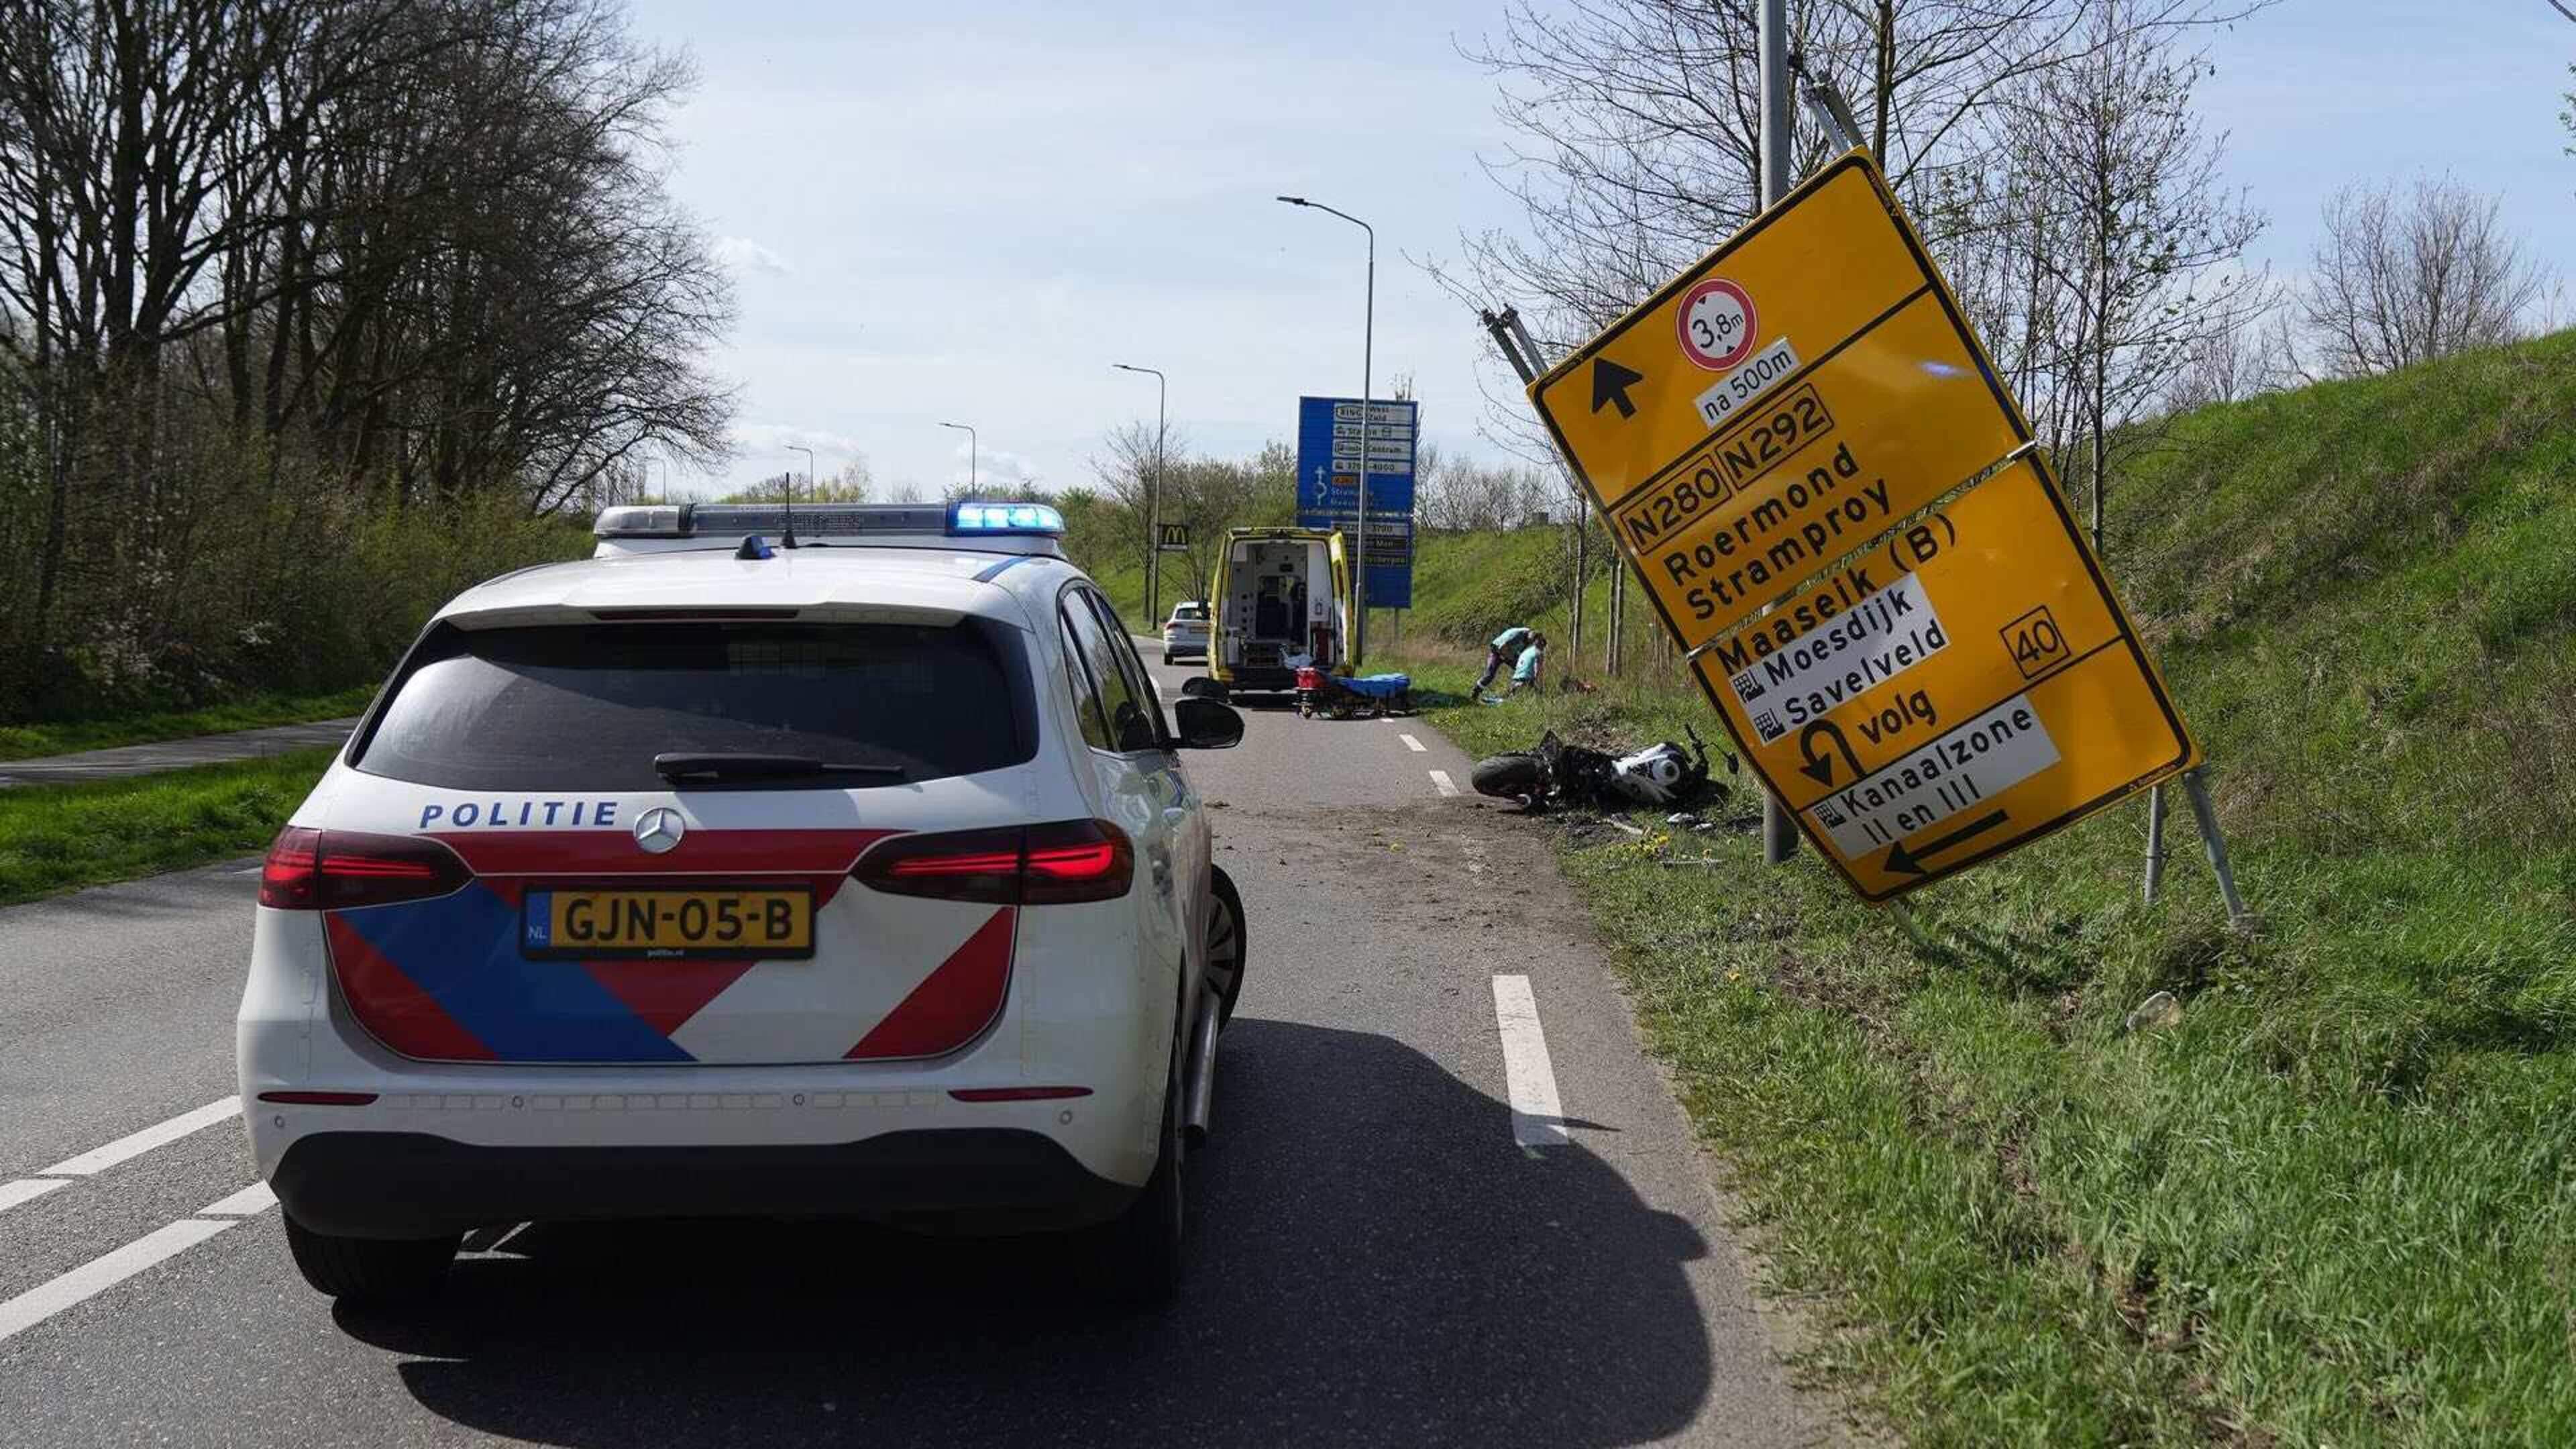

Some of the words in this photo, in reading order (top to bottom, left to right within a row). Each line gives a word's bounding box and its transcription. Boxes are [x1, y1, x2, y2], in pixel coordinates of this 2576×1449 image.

[1692, 313, 1743, 349] 3,8m
[1704, 394, 1731, 421] na
[1729, 350, 1792, 400] 500m
[1628, 468, 1721, 547] N280
[1723, 396, 1826, 480] N292
[1663, 441, 1860, 588] Roermond
[1686, 478, 1890, 621] Stramproy
[1716, 568, 1878, 676] Maaseik
[1889, 513, 1955, 573] (B)
[1763, 589, 1914, 686] Moesdijk
[1785, 619, 1947, 724] Savelveld
[2017, 619, 2059, 663] 40
[1857, 690, 1937, 745] volg
[1839, 708, 2033, 818] Kanaalzone
[419, 801, 618, 828] POLITIE
[1896, 804, 1935, 831] en
[528, 925, 548, 940] NL
[565, 898, 793, 942] GJN-05-B
